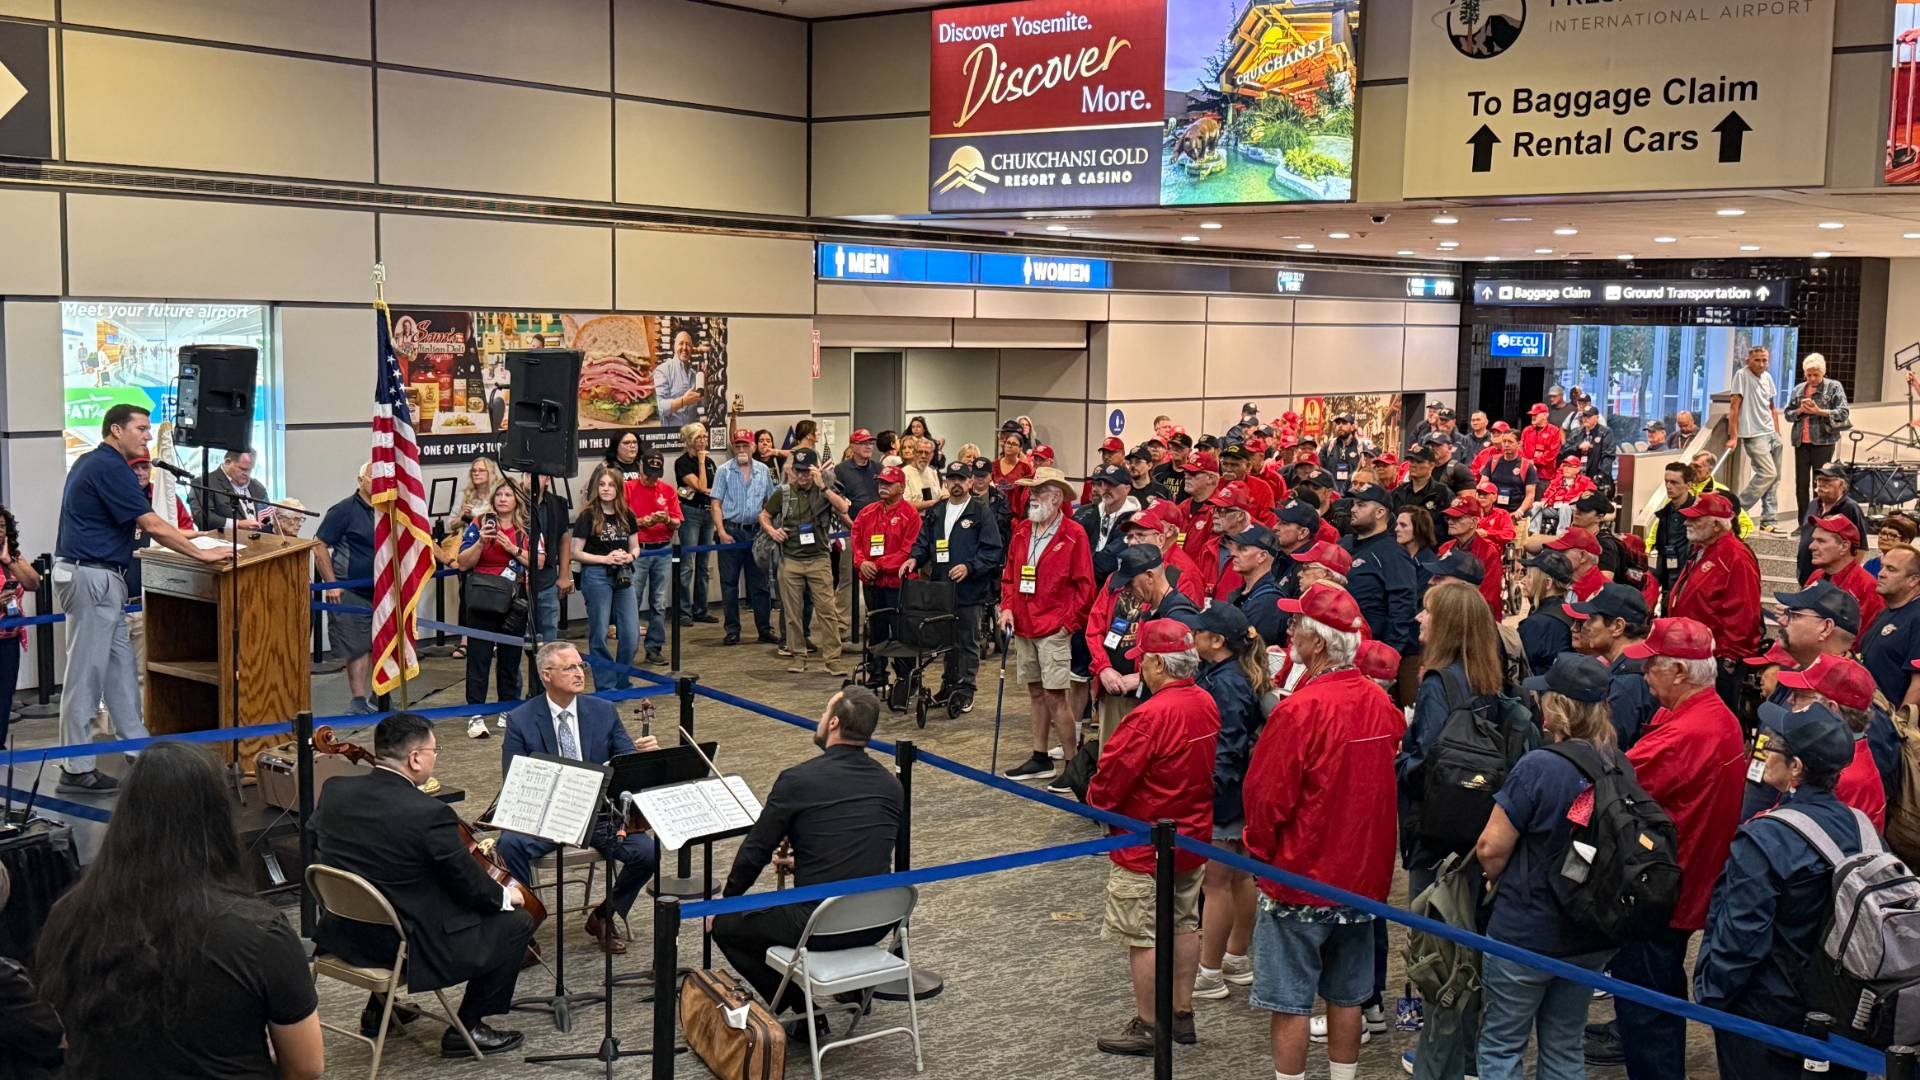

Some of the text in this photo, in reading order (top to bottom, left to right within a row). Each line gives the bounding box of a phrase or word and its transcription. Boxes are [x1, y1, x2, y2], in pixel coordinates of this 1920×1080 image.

[1549, 0, 1813, 32] INTERNATIONAL AIRPORT
[938, 14, 1093, 43] Discover Yosemite.
[1236, 38, 1325, 85] CHUKCHANSI
[953, 36, 1132, 128] Discover
[1081, 86, 1151, 114] More.
[1467, 76, 1758, 118] To Baggage Claim
[1512, 126, 1698, 157] Rental Cars
[991, 147, 1149, 170] CHUKCHANSI GOLD
[1004, 170, 1133, 187] RESORT & CASINO
[848, 252, 889, 274] MEN
[1033, 262, 1090, 282] WOMEN
[1514, 286, 1591, 300] Baggage Claim
[1623, 285, 1750, 301] Ground Transportation
[64, 303, 248, 320] Meet your future airport
[1510, 335, 1539, 346] EECU
[1521, 346, 1538, 354] ATM
[423, 445, 441, 456] ONE
[443, 444, 455, 454] OF
[457, 442, 484, 454] YELP'S
[579, 439, 588, 449] IN
[590, 438, 604, 448] THE
[605, 438, 611, 448] U
